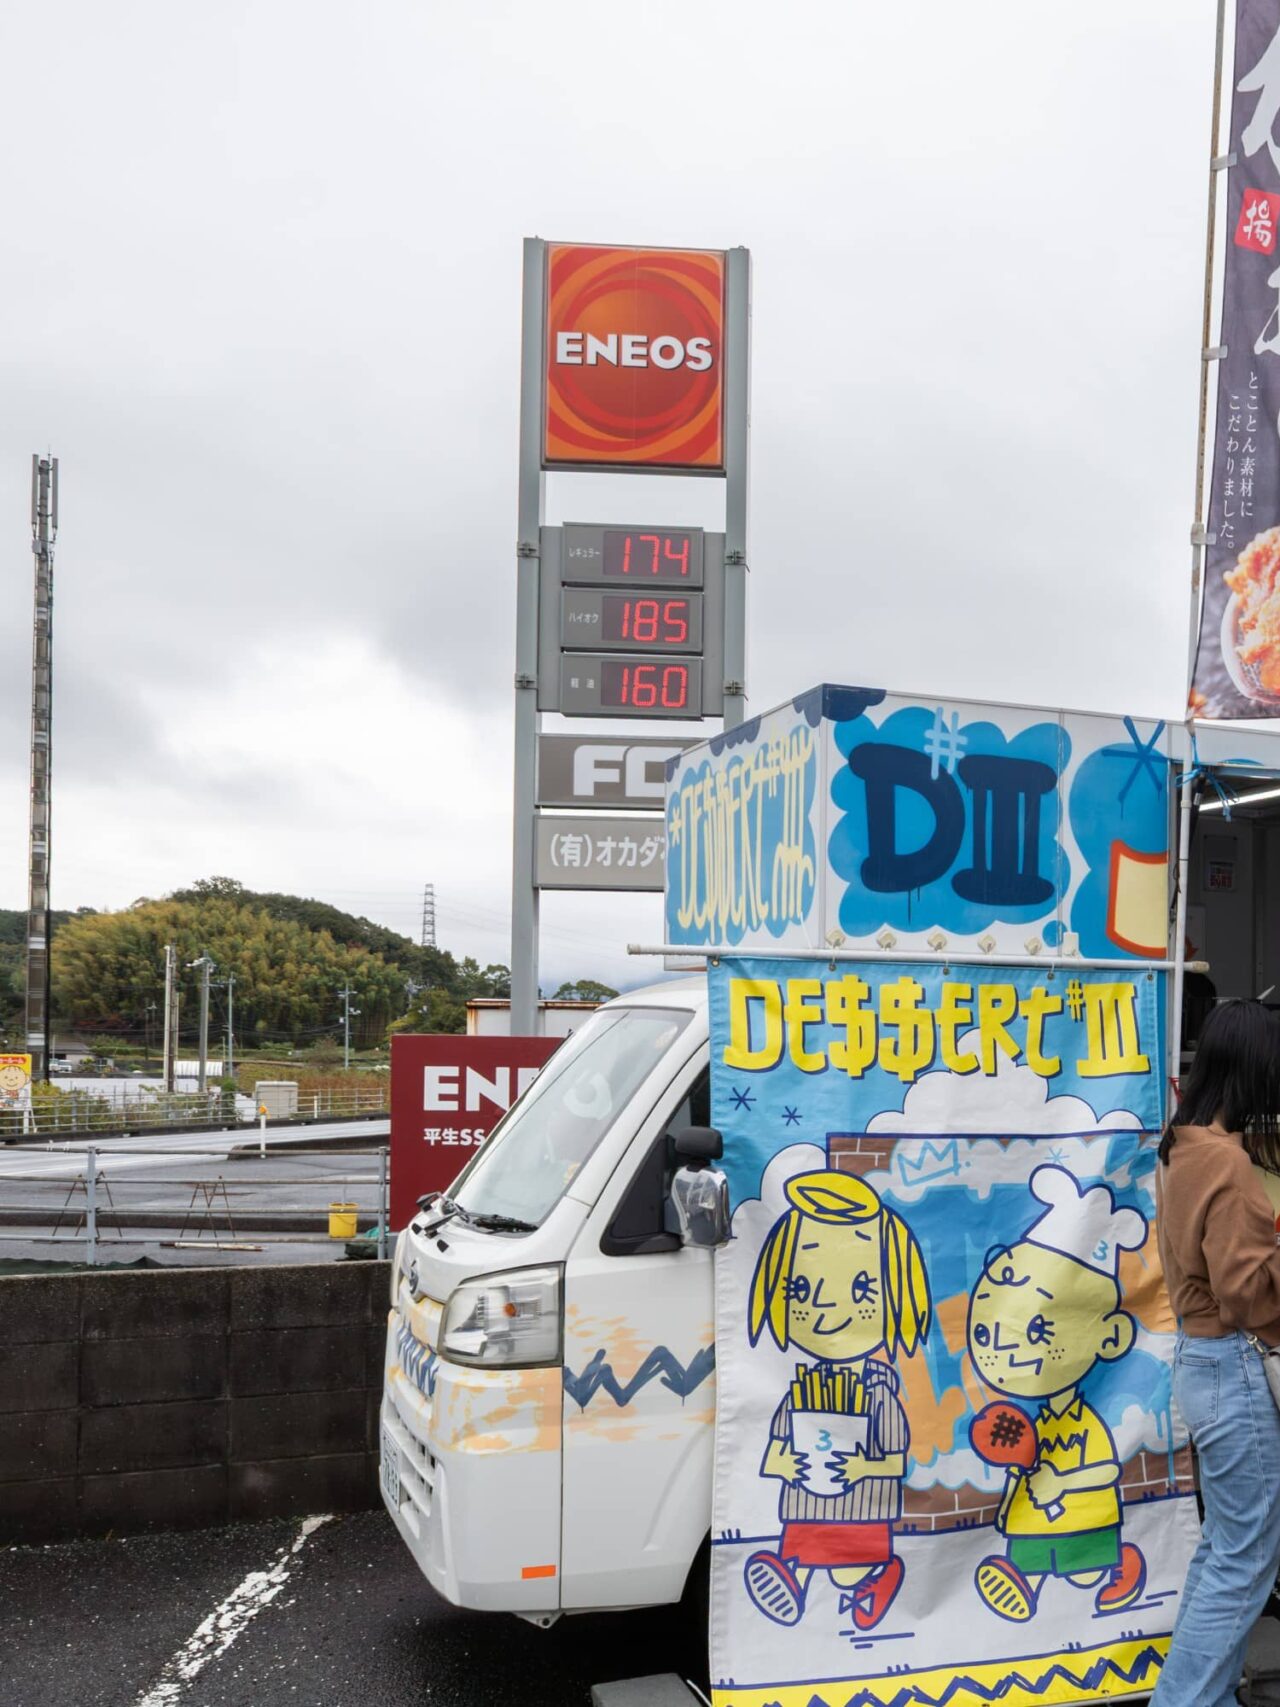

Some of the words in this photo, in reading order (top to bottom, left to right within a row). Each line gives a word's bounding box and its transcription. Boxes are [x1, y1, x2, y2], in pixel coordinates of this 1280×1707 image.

[556, 331, 713, 371] ENEOS
[1240, 372, 1258, 517] とことん素材に
[623, 534, 689, 575] 174
[568, 612, 599, 624] ハイオク
[621, 600, 687, 642] 185
[621, 665, 688, 708] 160
[550, 833, 667, 868] (有)オカダ
[423, 1127, 486, 1147] 平生SS
[815, 1428, 834, 1453] 3
